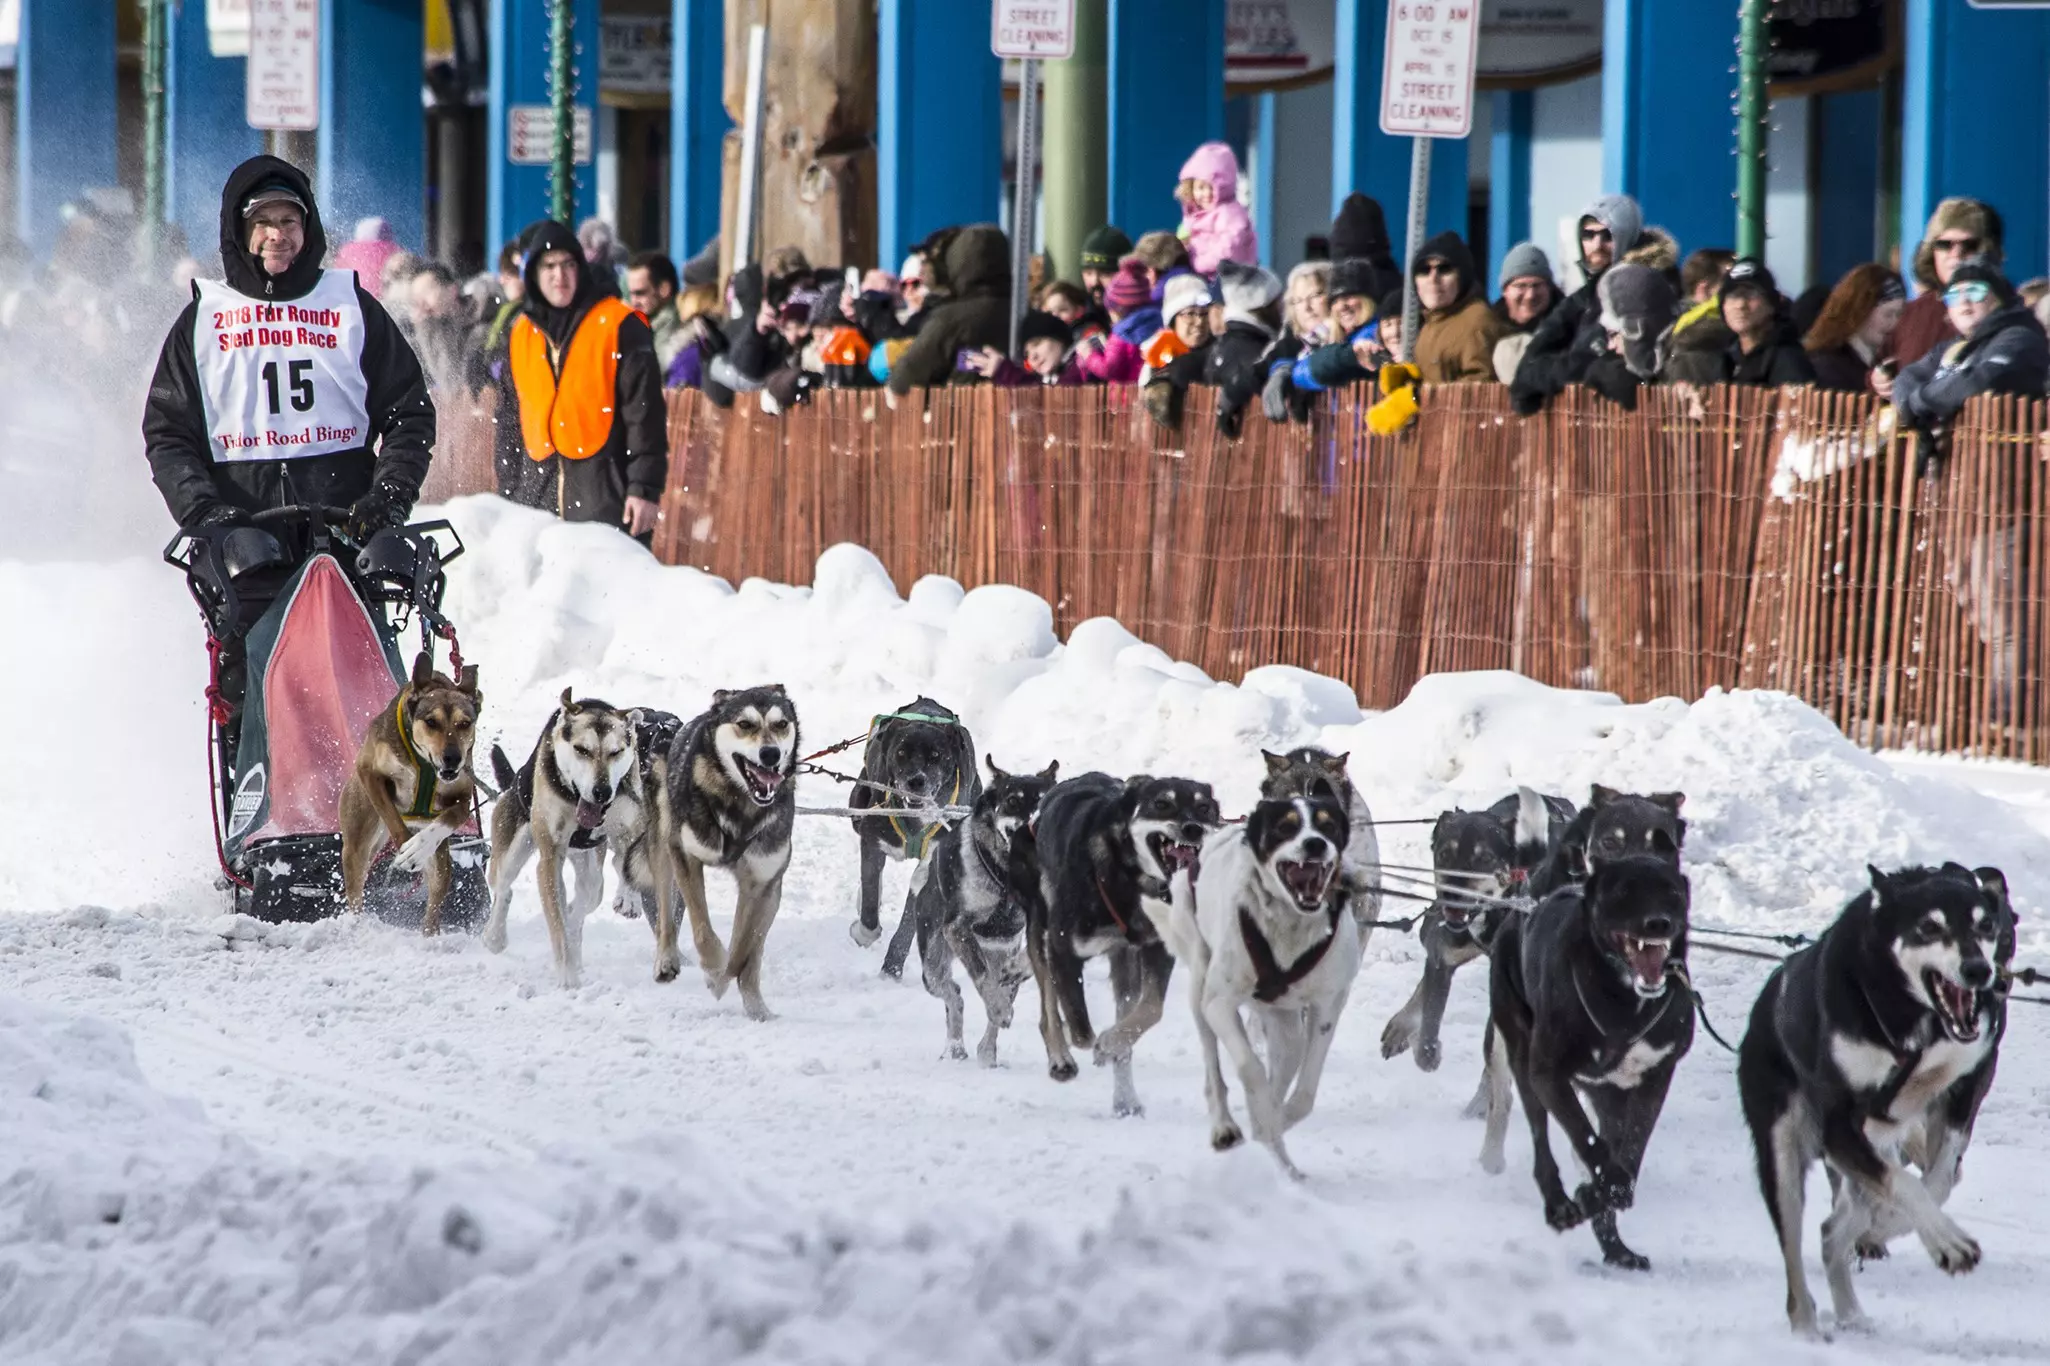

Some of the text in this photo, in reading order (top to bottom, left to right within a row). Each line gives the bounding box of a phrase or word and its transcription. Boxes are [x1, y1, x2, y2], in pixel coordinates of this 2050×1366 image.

[1007, 8, 1058, 26] STREET
[999, 28, 1065, 45] CLEANING
[1400, 82, 1456, 101] STREET
[1390, 102, 1462, 122] CLEANING
[213, 304, 342, 330] 2018 Fur Rondy
[218, 327, 338, 352] Sled Dog Race
[262, 359, 315, 415] 15
[265, 427, 311, 446] Road
[315, 425, 358, 444] Bingo
